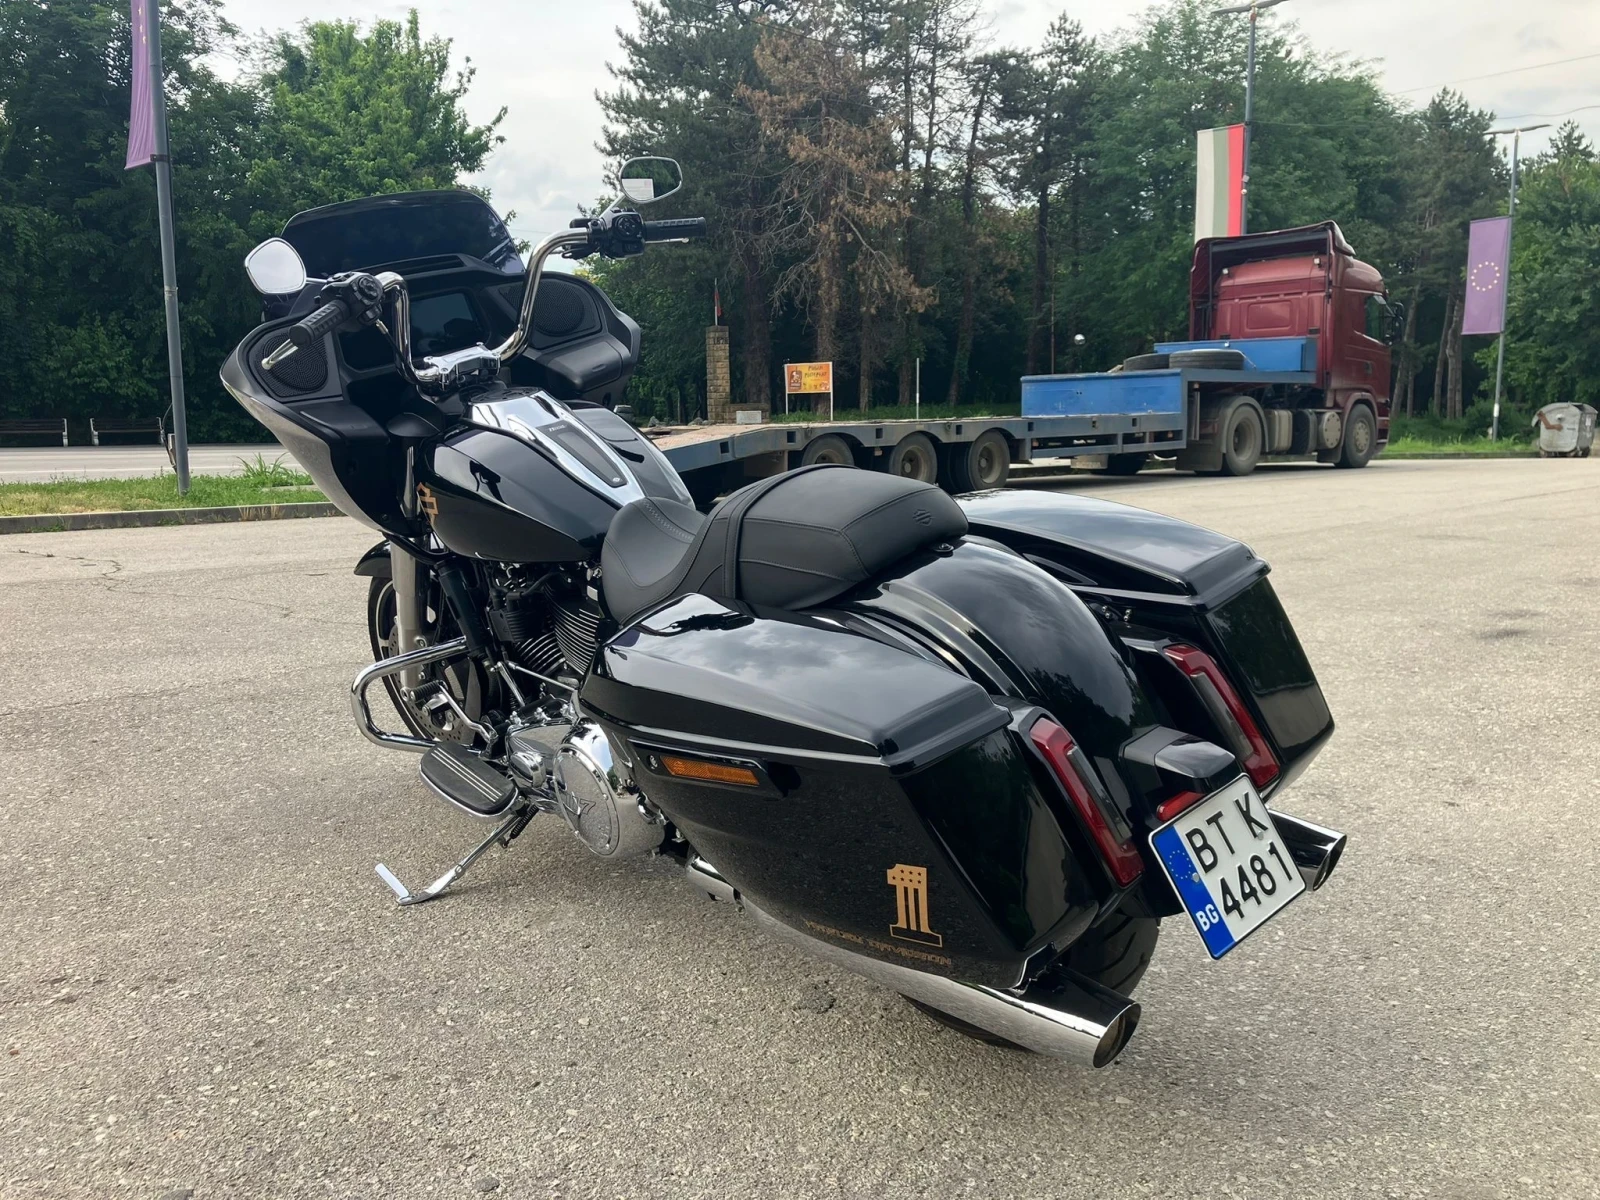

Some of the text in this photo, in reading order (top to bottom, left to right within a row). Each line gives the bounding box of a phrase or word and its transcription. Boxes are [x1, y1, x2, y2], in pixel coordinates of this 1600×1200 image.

[1233, 791, 1269, 839] K
[1219, 841, 1293, 919] 4481
[1195, 903, 1220, 932] BG
